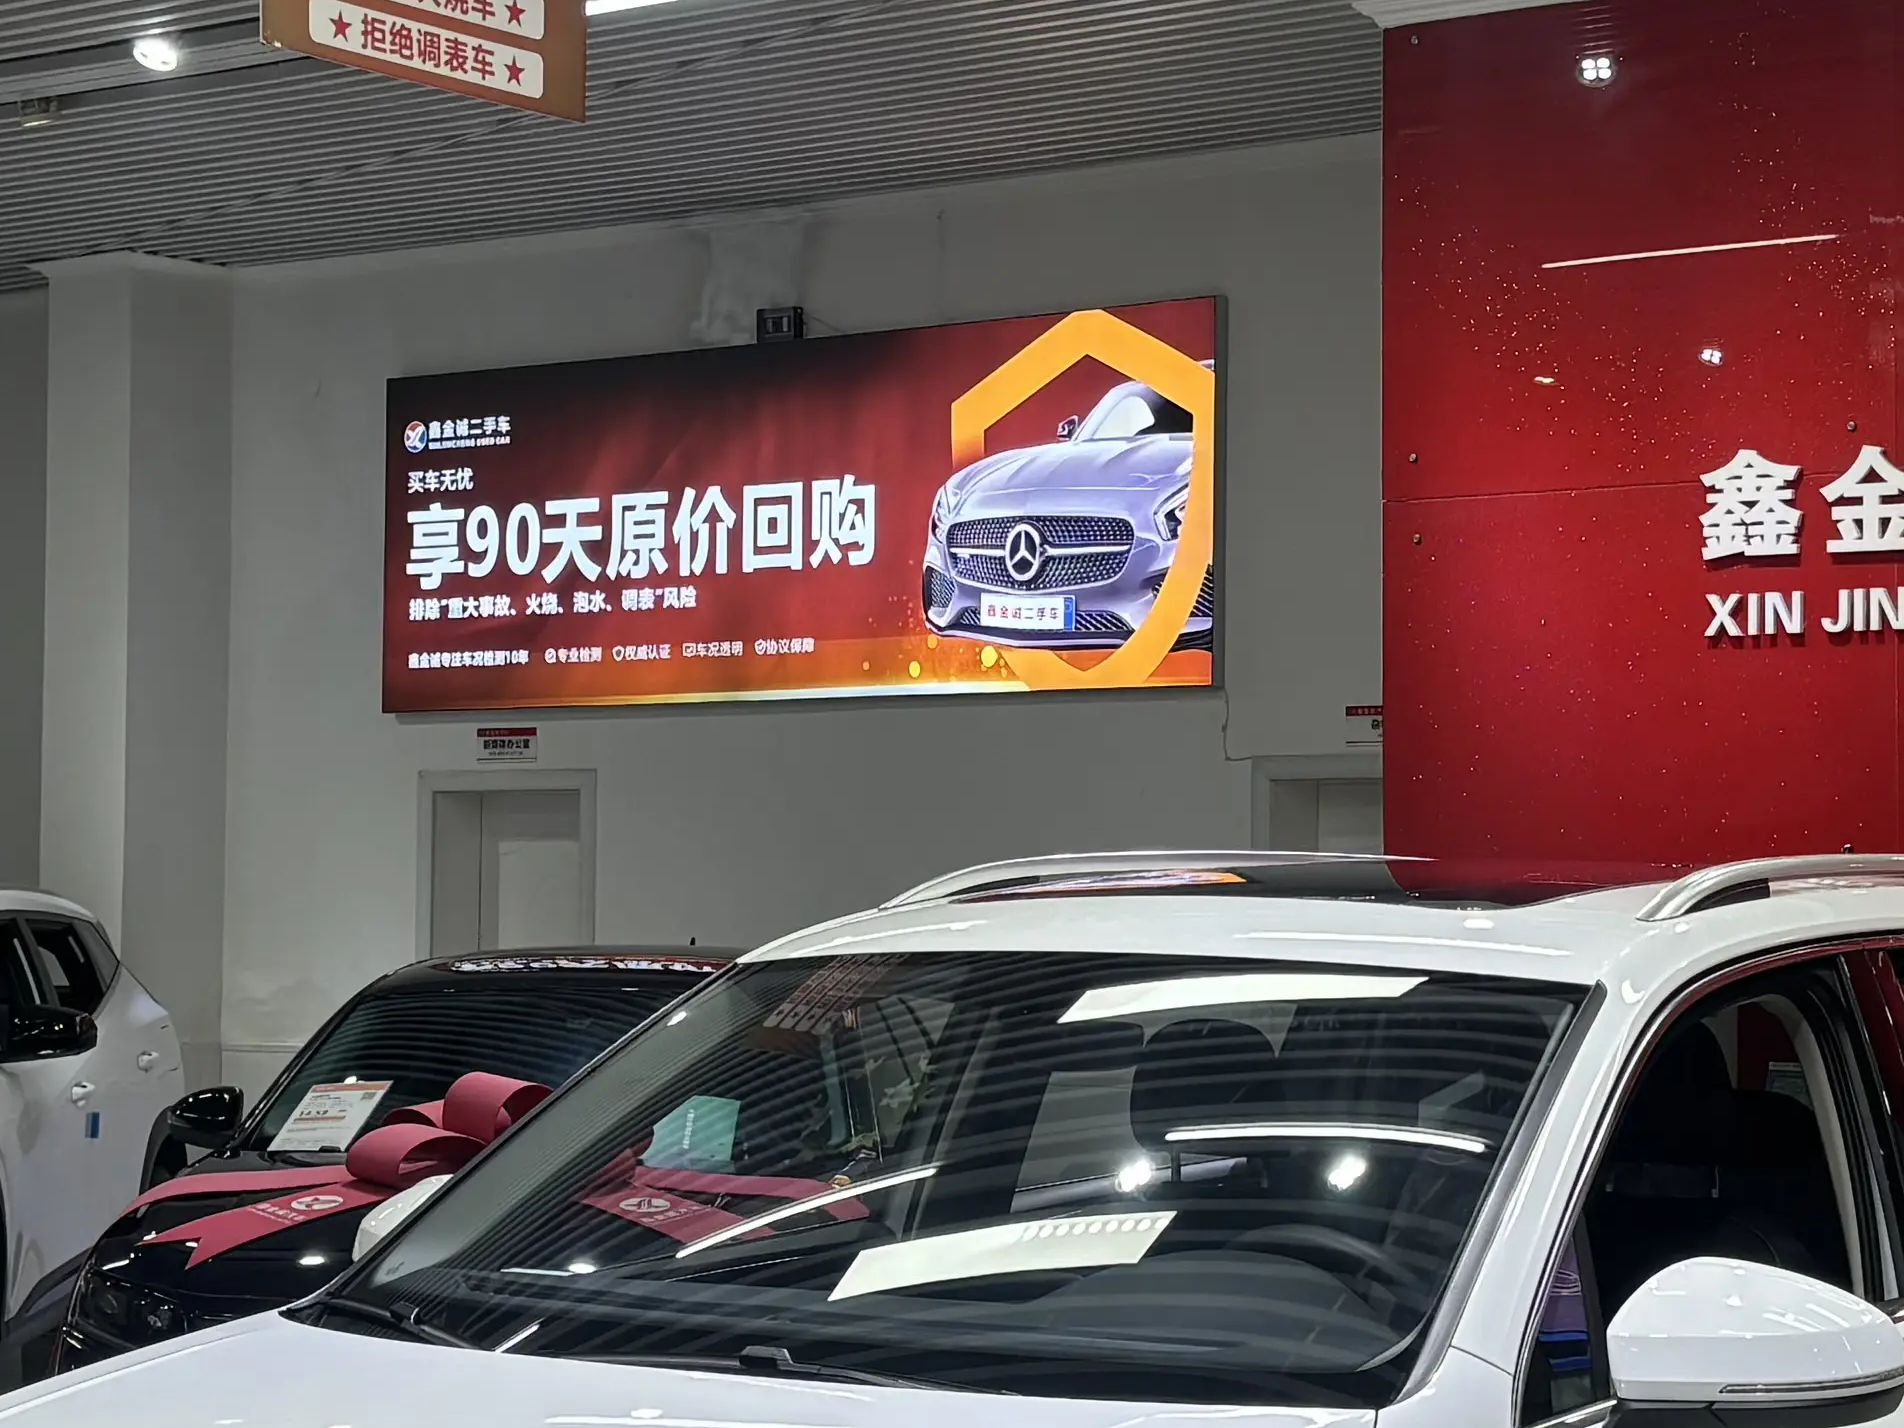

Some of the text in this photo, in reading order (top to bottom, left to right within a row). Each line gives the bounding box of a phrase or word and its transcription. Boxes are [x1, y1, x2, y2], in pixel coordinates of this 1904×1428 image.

[361, 13, 496, 81] 拒绝调表车
[428, 415, 512, 440] 鑫金诚二手车
[476, 436, 495, 447] USED
[496, 435, 511, 445] CAR
[407, 467, 474, 494] 买车无忧
[405, 475, 876, 590] 享90天原价回购
[1704, 590, 1805, 638] XIN
[557, 646, 603, 664] 专业检测
[624, 643, 671, 661] 权威认证
[696, 640, 743, 657] 车况透明
[766, 637, 815, 656] 协议保障
